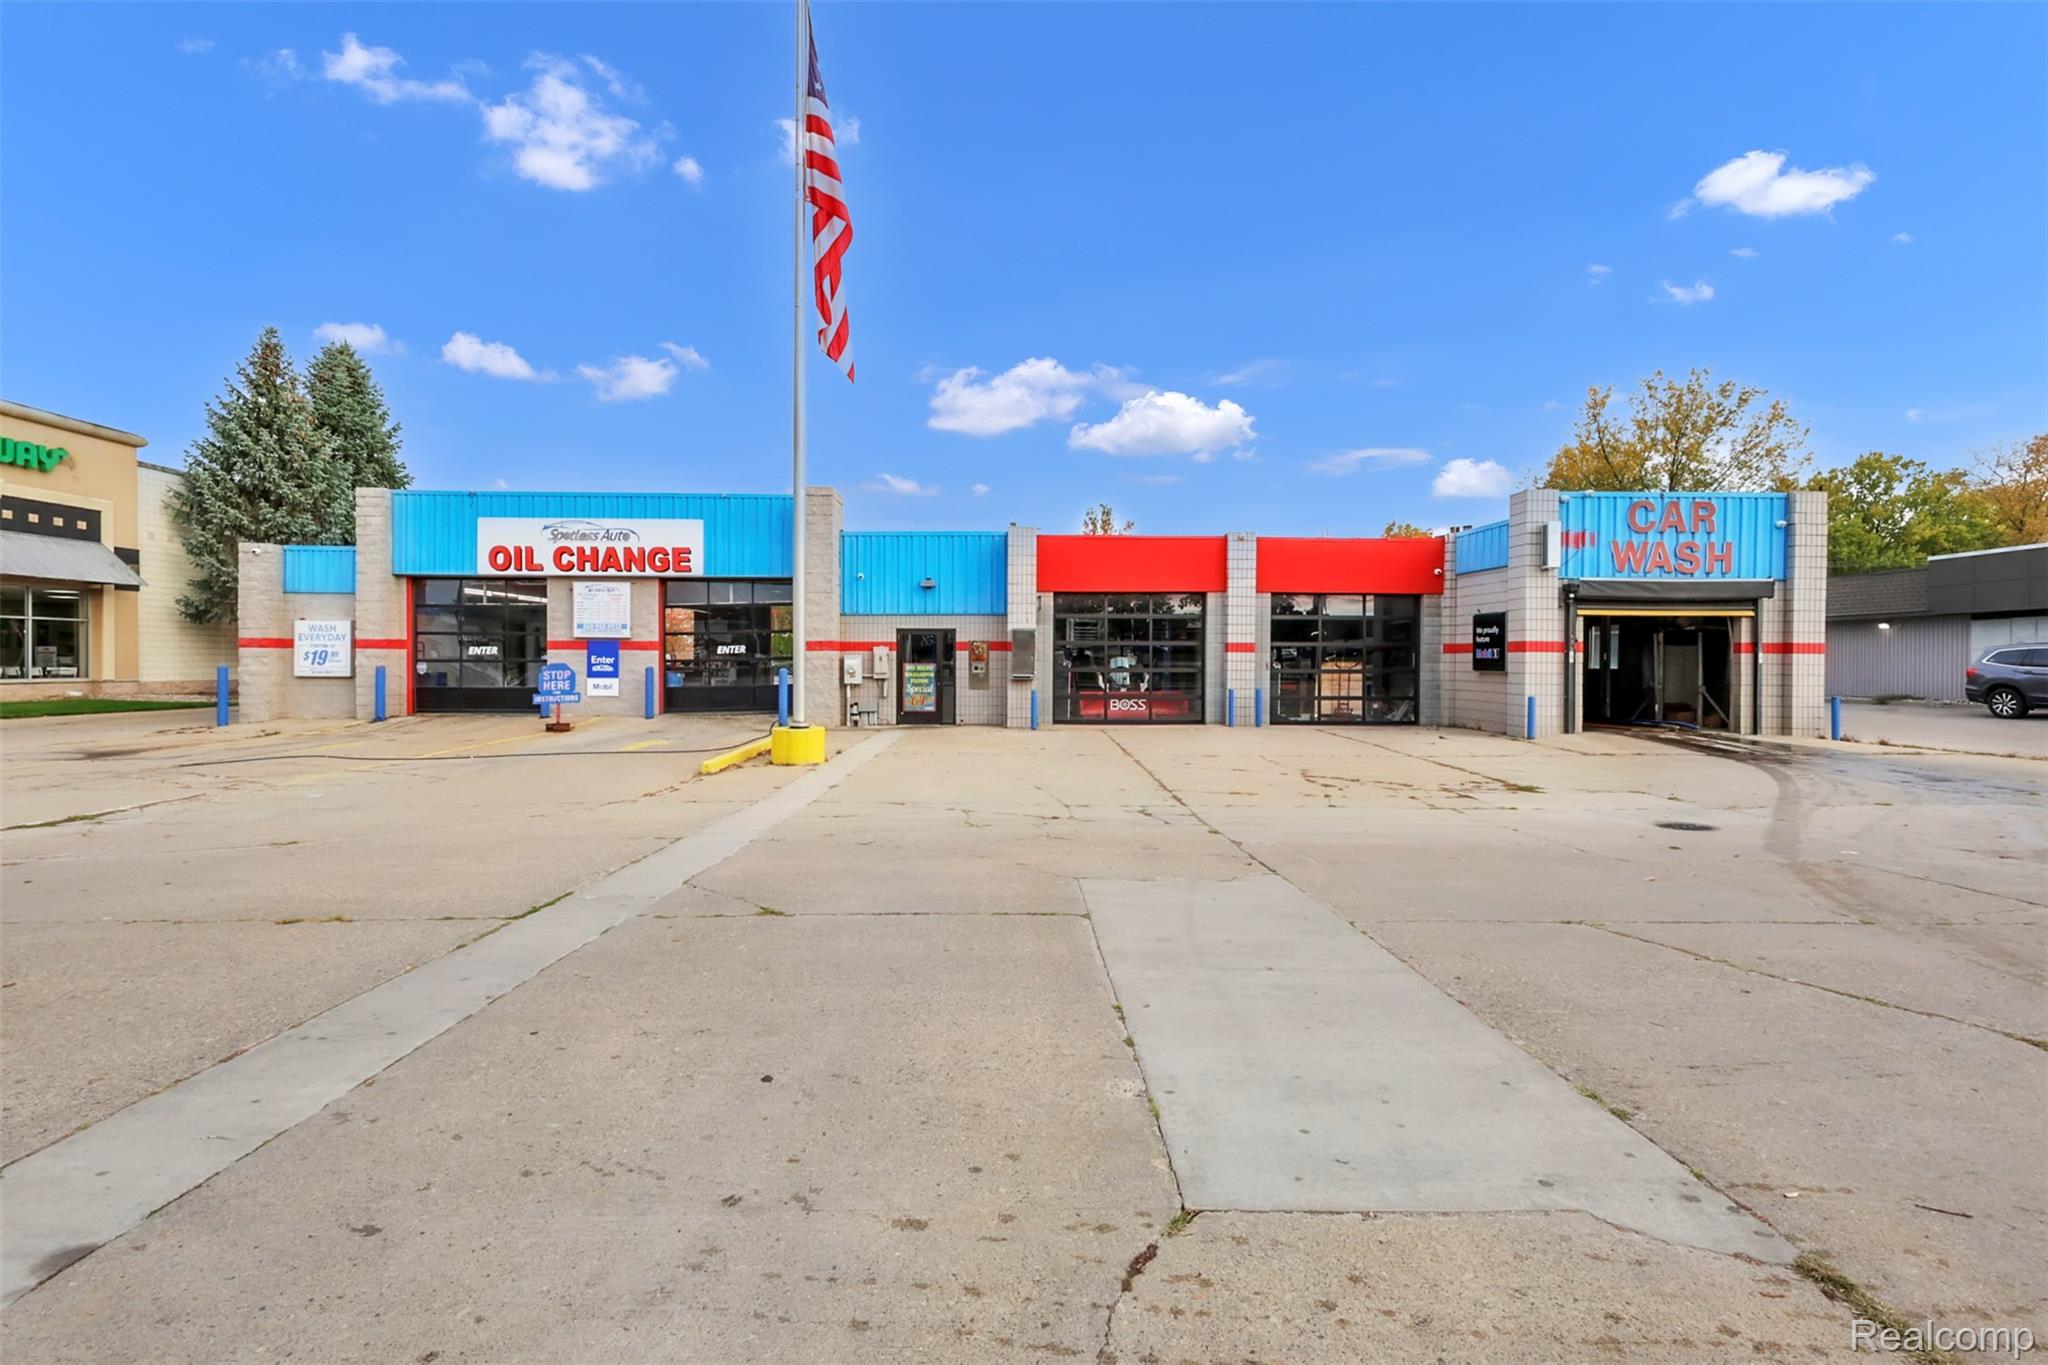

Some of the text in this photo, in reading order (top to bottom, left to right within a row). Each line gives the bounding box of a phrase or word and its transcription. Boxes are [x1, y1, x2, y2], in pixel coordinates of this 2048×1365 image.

[1627, 500, 1716, 533] CAR
[601, 528, 631, 542] Auto
[488, 545, 692, 572] OIL CHANGE
[1611, 540, 1733, 574] WASH
[308, 624, 336, 633] WASH
[298, 632, 347, 642] EVERYDAY
[468, 646, 498, 655] ENTER
[717, 644, 746, 655] ENTER
[591, 655, 615, 664] Enter
[543, 670, 572, 680] STOP
[543, 680, 571, 691] HERE
[1109, 699, 1147, 711] BOSS
